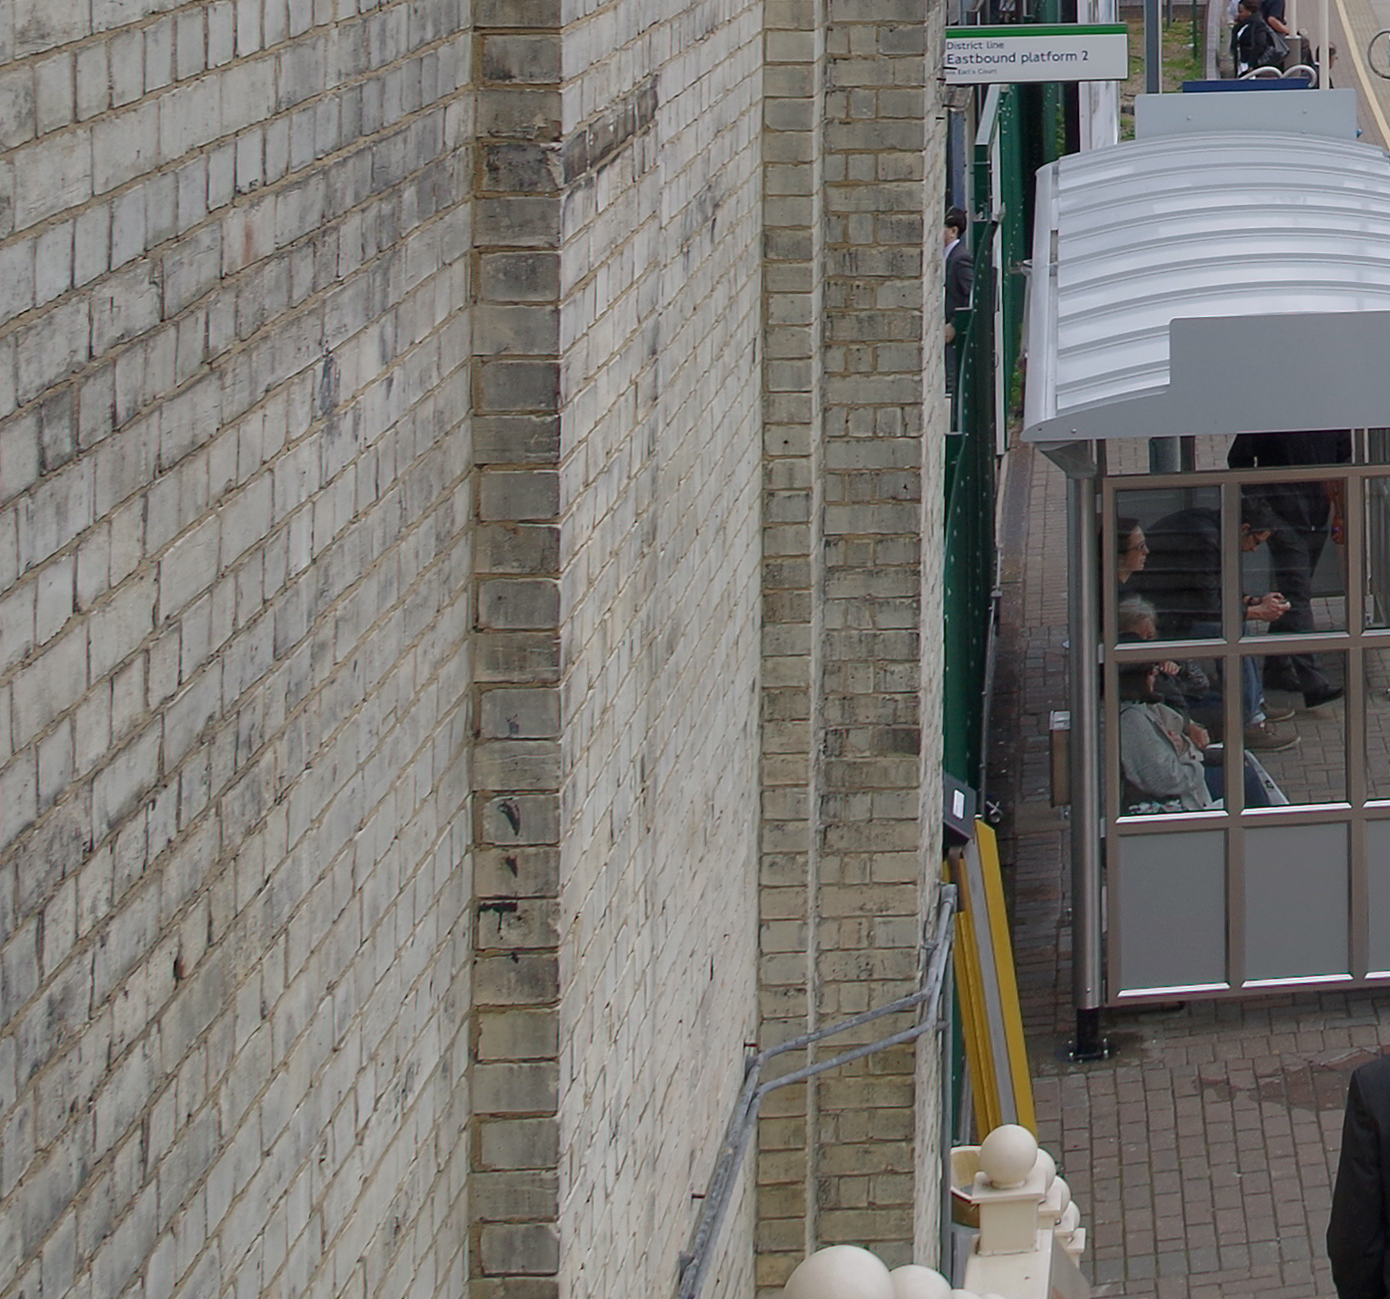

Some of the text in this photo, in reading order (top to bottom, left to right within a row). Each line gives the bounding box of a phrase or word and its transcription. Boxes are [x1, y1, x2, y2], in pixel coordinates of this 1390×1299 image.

[947, 41, 1005, 50] District line
[946, 50, 1089, 65] Eastbound platform 2
[957, 68, 976, 76] Earl's
